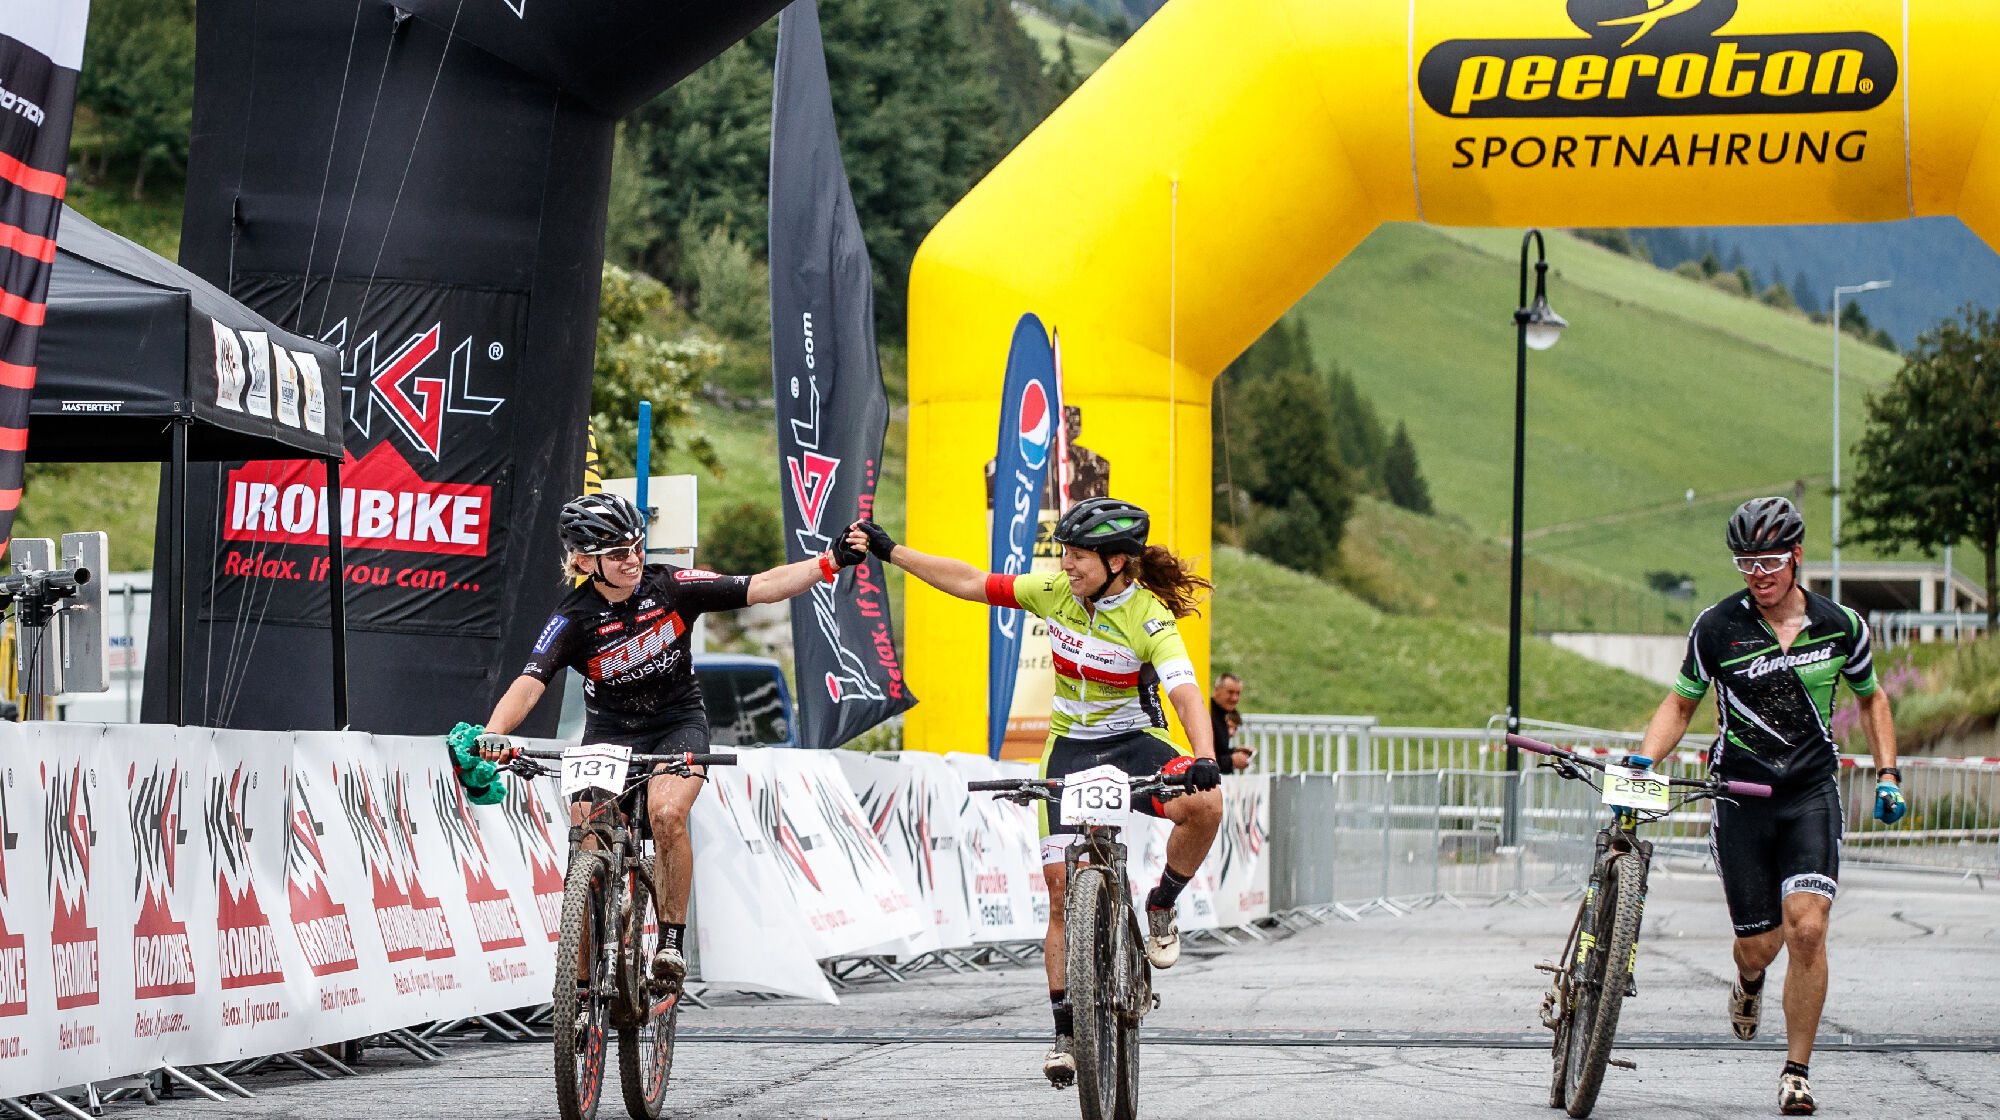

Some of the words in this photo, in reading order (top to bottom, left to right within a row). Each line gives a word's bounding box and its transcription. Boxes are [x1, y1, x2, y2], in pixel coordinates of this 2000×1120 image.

[1452, 129, 1868, 169] SPORTNAHRUNG
[62, 402, 122, 412] MASTERTENT
[231, 481, 482, 545] IRONBIKE
[225, 551, 301, 581] Relax.
[308, 556, 331, 582] If
[569, 760, 617, 780] 131
[1071, 785, 1123, 810] 133
[1614, 777, 1662, 797] 282
[134, 933, 194, 988] IRONBIKE
